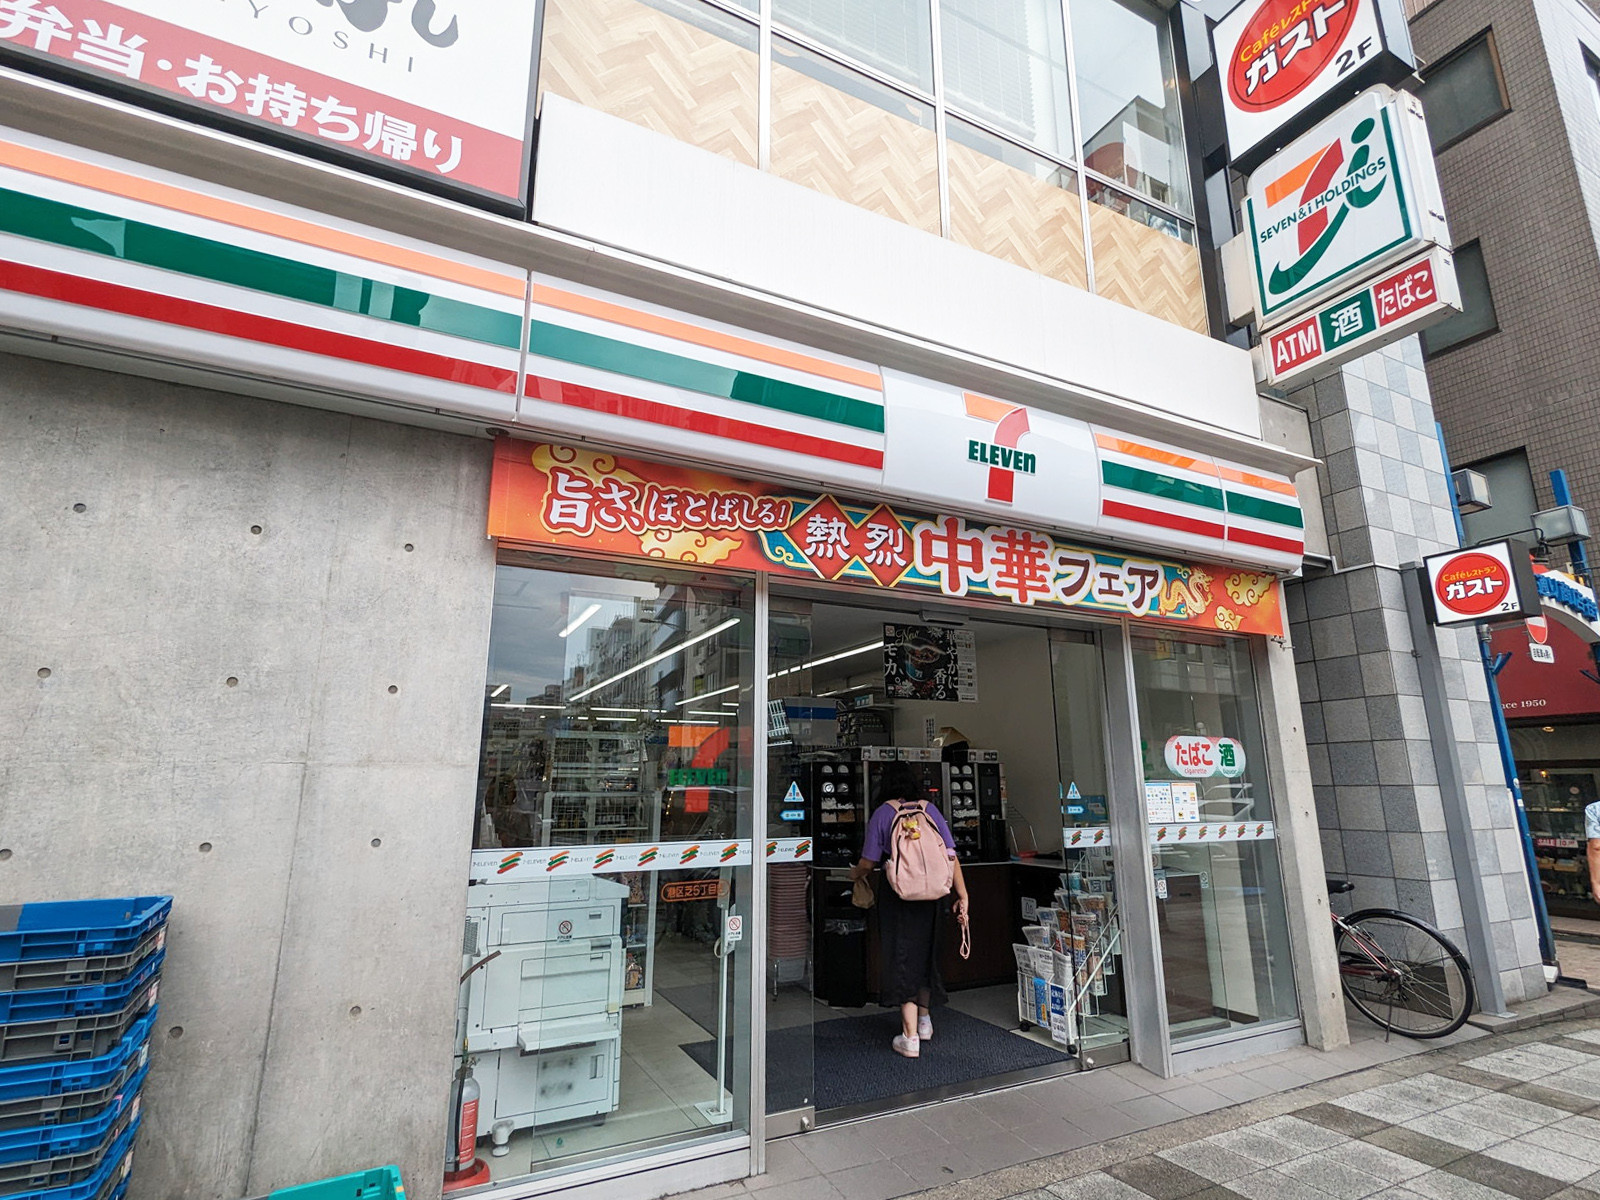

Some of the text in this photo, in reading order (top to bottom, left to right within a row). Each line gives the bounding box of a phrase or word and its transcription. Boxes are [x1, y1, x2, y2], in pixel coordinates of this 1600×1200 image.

[1240, 0, 1319, 62] Caféレスト
[1245, 0, 1346, 97] ガスト
[1335, 36, 1372, 77] 2F
[1315, 156, 1386, 209] HOLDINGS
[1378, 269, 1433, 318] たばこ
[1330, 301, 1364, 343] 酒
[1276, 325, 1318, 368] ATM
[1446, 577, 1503, 601] ガスト
[1501, 602, 1517, 611] 2F
[934, 668, 948, 699] 香る
[1521, 699, 1547, 708] 1950
[1175, 742, 1236, 767] たばこ 酒
